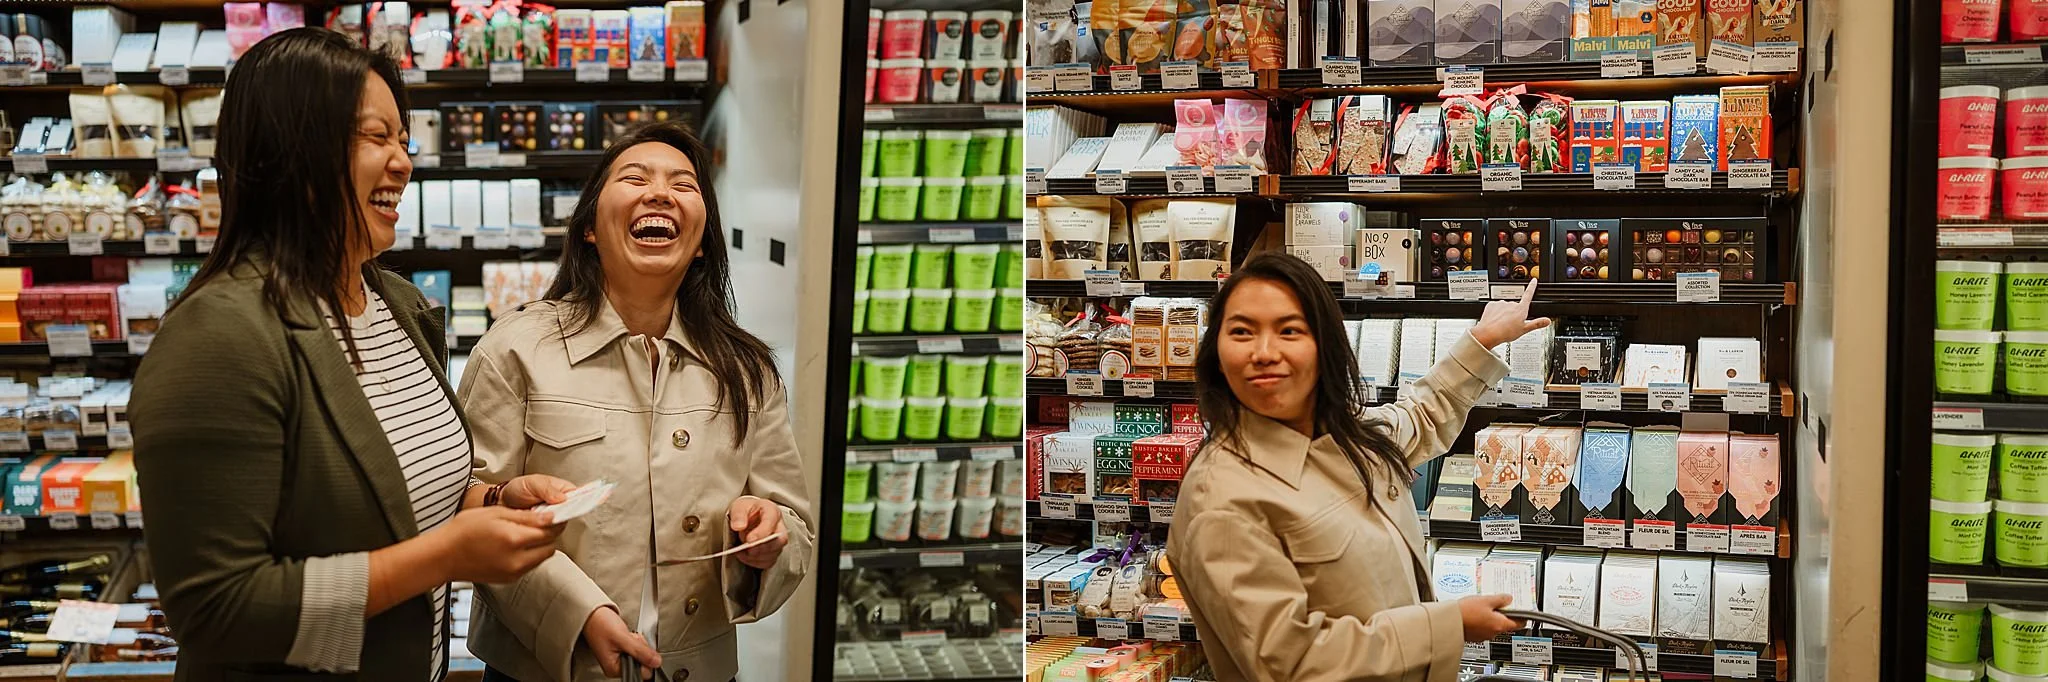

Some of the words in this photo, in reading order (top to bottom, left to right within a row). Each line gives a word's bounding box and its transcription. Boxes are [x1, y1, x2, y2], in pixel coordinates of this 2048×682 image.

[1657, 0, 1697, 9] GOOD
[1709, 0, 1750, 9] GOOD
[1574, 41, 1607, 52] Malvi
[1618, 39, 1651, 50] Malvi
[1949, 174, 1986, 183] BI-RITE
[1364, 244, 1385, 260] BOX
[1952, 276, 1990, 286] BI-RITE
[2012, 278, 2048, 287] BI-RITE
[1944, 346, 1981, 355] BI-RITE
[2010, 348, 2046, 357] BI-RITE
[1116, 424, 1135, 434] EGG
[1137, 424, 1160, 434] NOG
[1960, 450, 1990, 458] BI-RITE
[2010, 450, 2048, 459] BI-RITE
[1096, 460, 1116, 468] EGG
[1688, 456, 1714, 472] Ritual
[1135, 466, 1182, 475] PEPPERMINT
[1951, 518, 1984, 527] BI-RITE
[2005, 518, 2042, 529] BI-RITE
[2005, 530, 2024, 538] Coffee
[1928, 610, 1956, 620] I-RITE
[2011, 623, 2048, 633] BI-RITE
